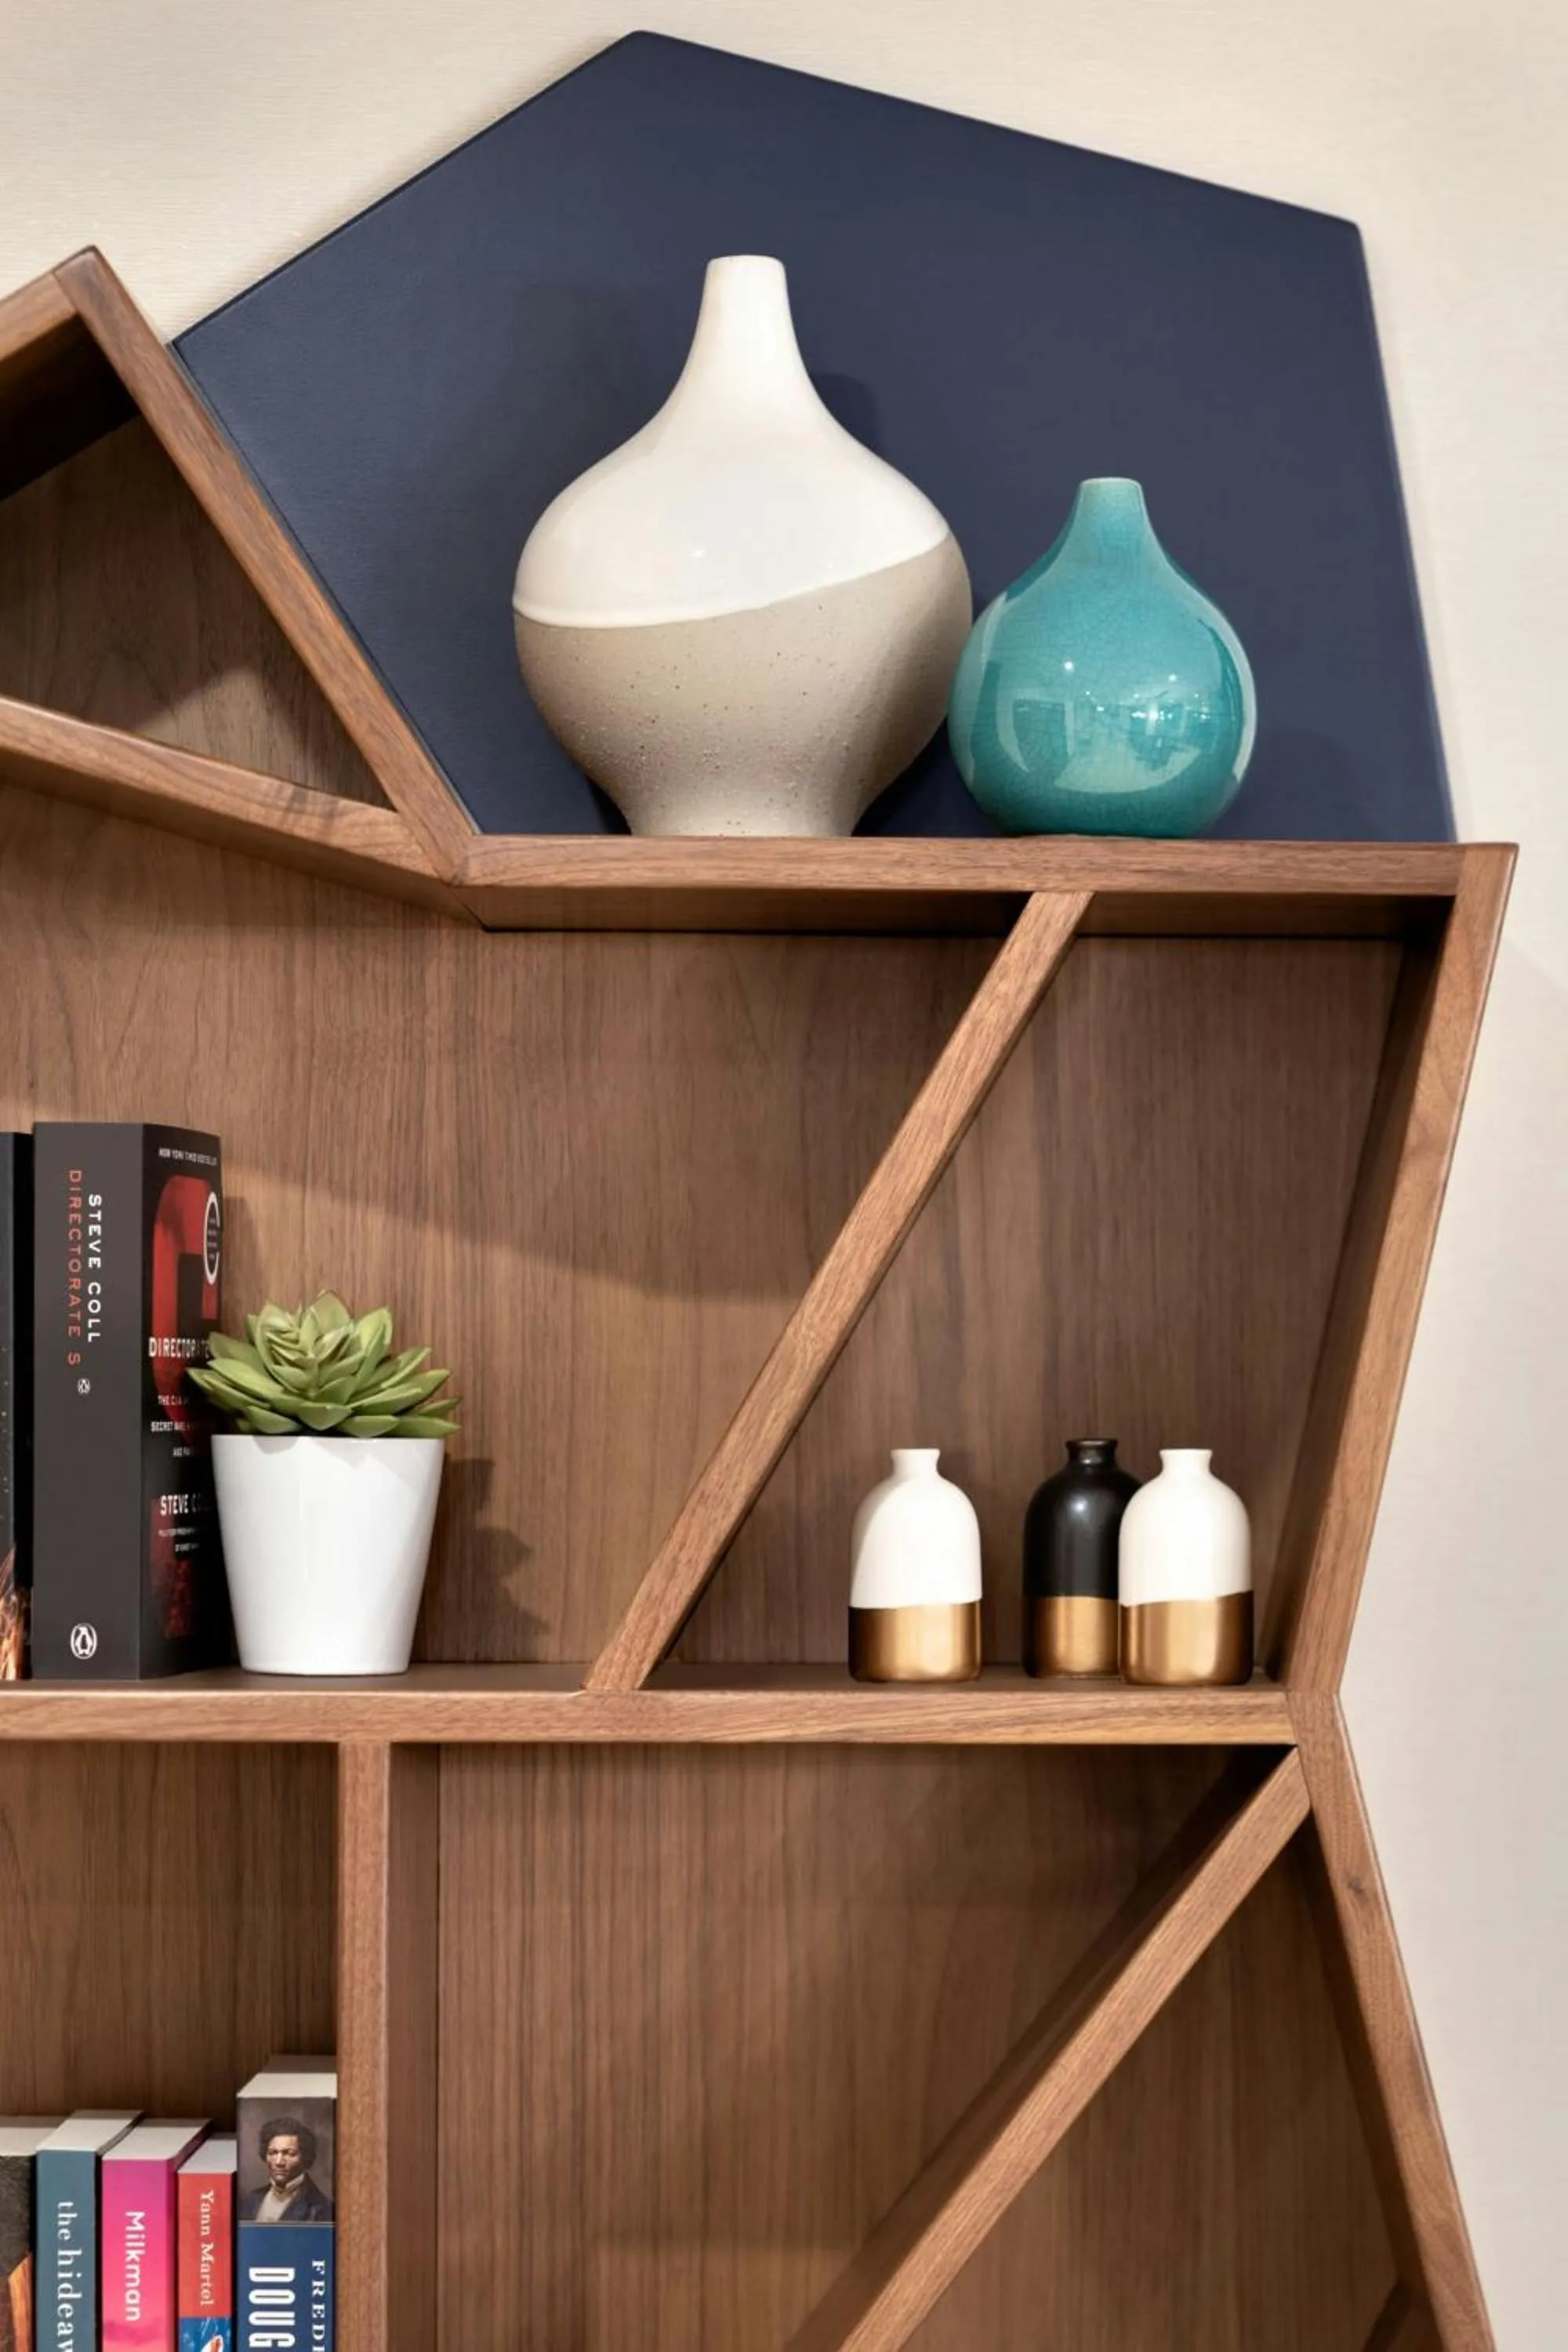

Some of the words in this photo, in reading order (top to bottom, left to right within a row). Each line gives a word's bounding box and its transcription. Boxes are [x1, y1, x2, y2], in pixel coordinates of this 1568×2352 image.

[68, 1170, 82, 1338] DIRECTORATE
[89, 1193, 102, 1269] STEVE
[88, 1281, 101, 1343] COLL
[68, 1351, 81, 1365] S
[160, 1494, 189, 1516] STEVE
[57, 2201, 78, 2241] the
[200, 2189, 215, 2237] Yann
[125, 2211, 146, 2322] Milkman
[200, 2242, 215, 2307] Martel
[249, 2267, 296, 2348] DOUG
